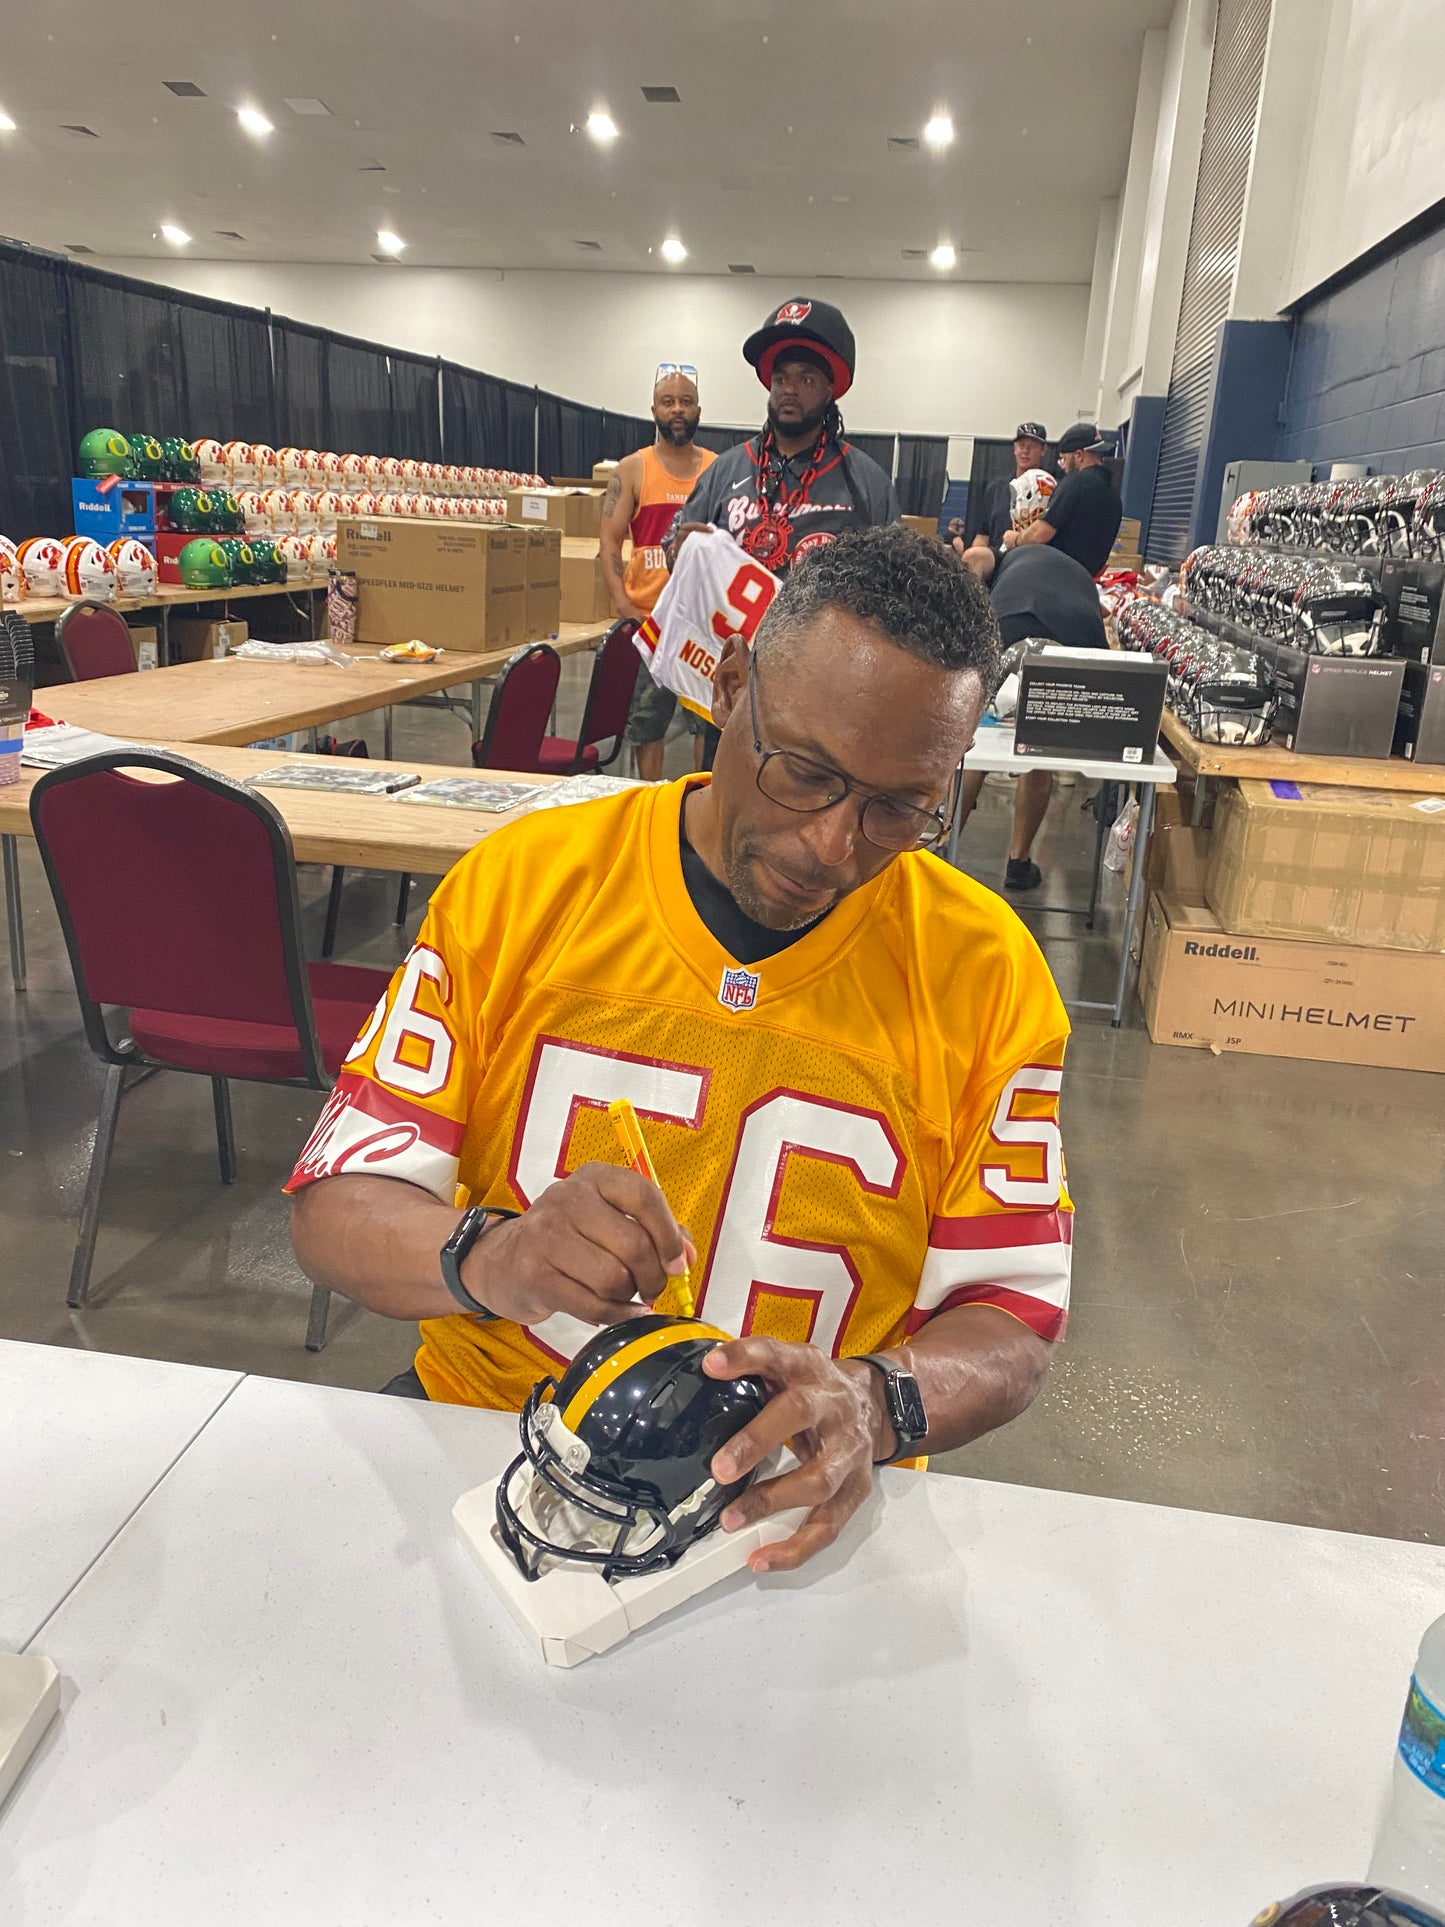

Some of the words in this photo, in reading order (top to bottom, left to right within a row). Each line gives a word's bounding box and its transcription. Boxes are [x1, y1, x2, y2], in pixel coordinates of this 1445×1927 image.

[346, 528, 391, 542] Riell
[357, 578, 397, 588] SPEEDFLEX
[399, 581, 433, 591] MID-SIZE
[436, 584, 465, 593] HELMET
[1184, 941, 1257, 961] Riddell
[724, 984, 751, 1006] NFL
[1213, 998, 1274, 1020] MINI
[1281, 1005, 1416, 1033] HELMET
[1173, 1031, 1193, 1040] RMX
[507, 1034, 908, 1367] 56
